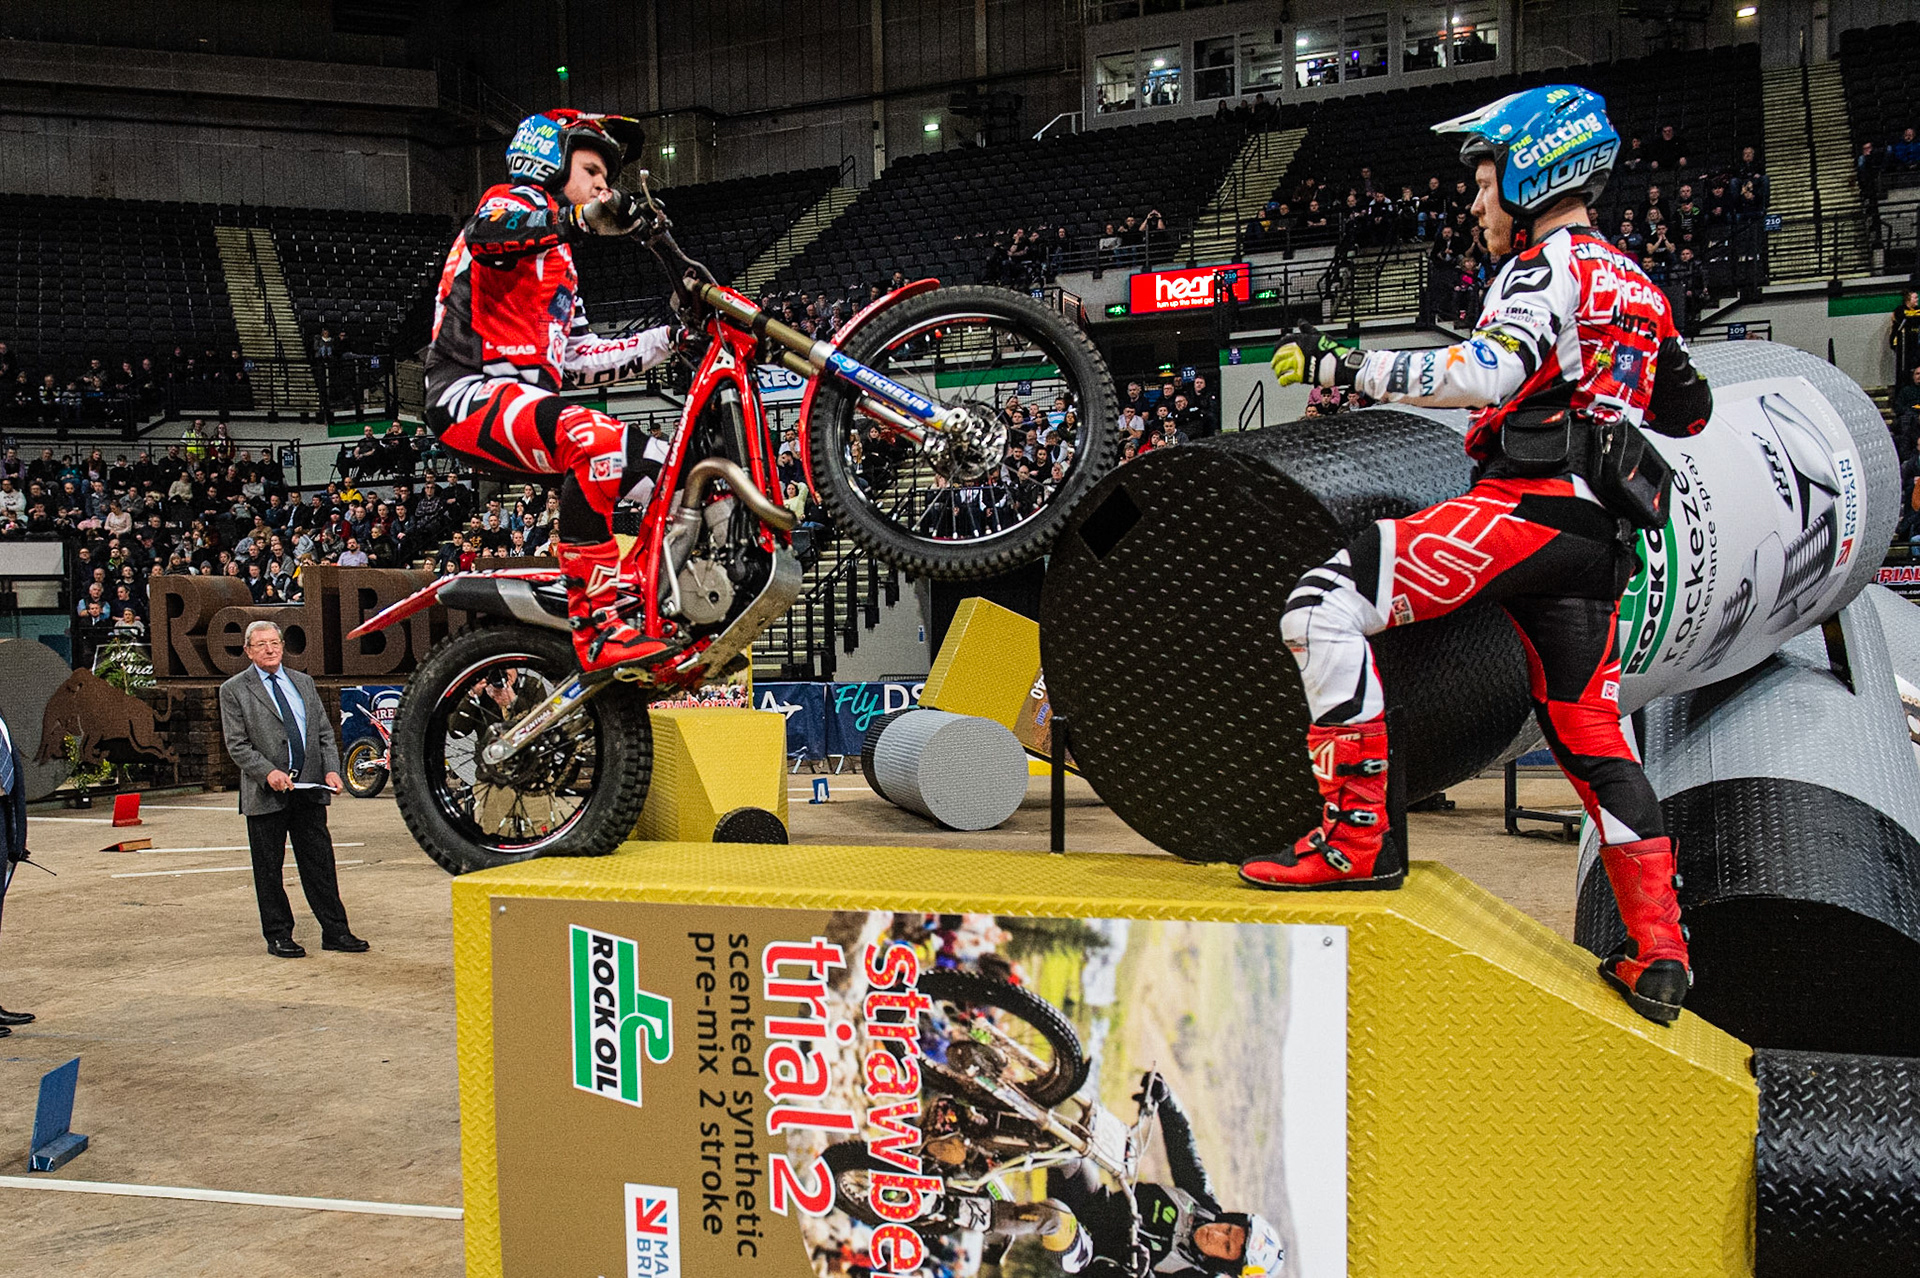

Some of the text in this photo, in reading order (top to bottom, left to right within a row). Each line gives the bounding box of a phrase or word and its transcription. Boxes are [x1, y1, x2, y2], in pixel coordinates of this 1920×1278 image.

[1509, 134, 1533, 152] THE
[1513, 112, 1603, 170] Gritting
[1537, 130, 1593, 168] COMPANY
[1519, 138, 1616, 207] MOTS
[1765, 218, 1781, 226] 210
[1156, 270, 1217, 301] hear
[1505, 306, 1533, 317] TRIAL
[1591, 269, 1665, 316] GASGAS
[1729, 327, 1745, 335] 109
[756, 369, 803, 388] REO
[855, 368, 929, 411] MICHELIN
[1183, 370, 1196, 379] 110
[669, 394, 694, 467] GASGAS
[1838, 460, 1852, 537] MADE IN
[1844, 458, 1857, 535] BRITAIN
[1662, 470, 1705, 664] rockeze
[1674, 452, 1718, 667] maintenance spray
[149, 561, 500, 677] Red Bu
[1625, 561, 1665, 675] ROCK
[816, 781, 828, 801] 4
[592, 934, 618, 1092] ROCK OIL
[687, 932, 729, 1235] pre-mix 2 stroke
[727, 933, 764, 1258] scented synthetic
[762, 936, 860, 1218] trial 2
[863, 943, 945, 1278] strawbe
[637, 1237, 652, 1278] BRI
[653, 1239, 669, 1278] MA
